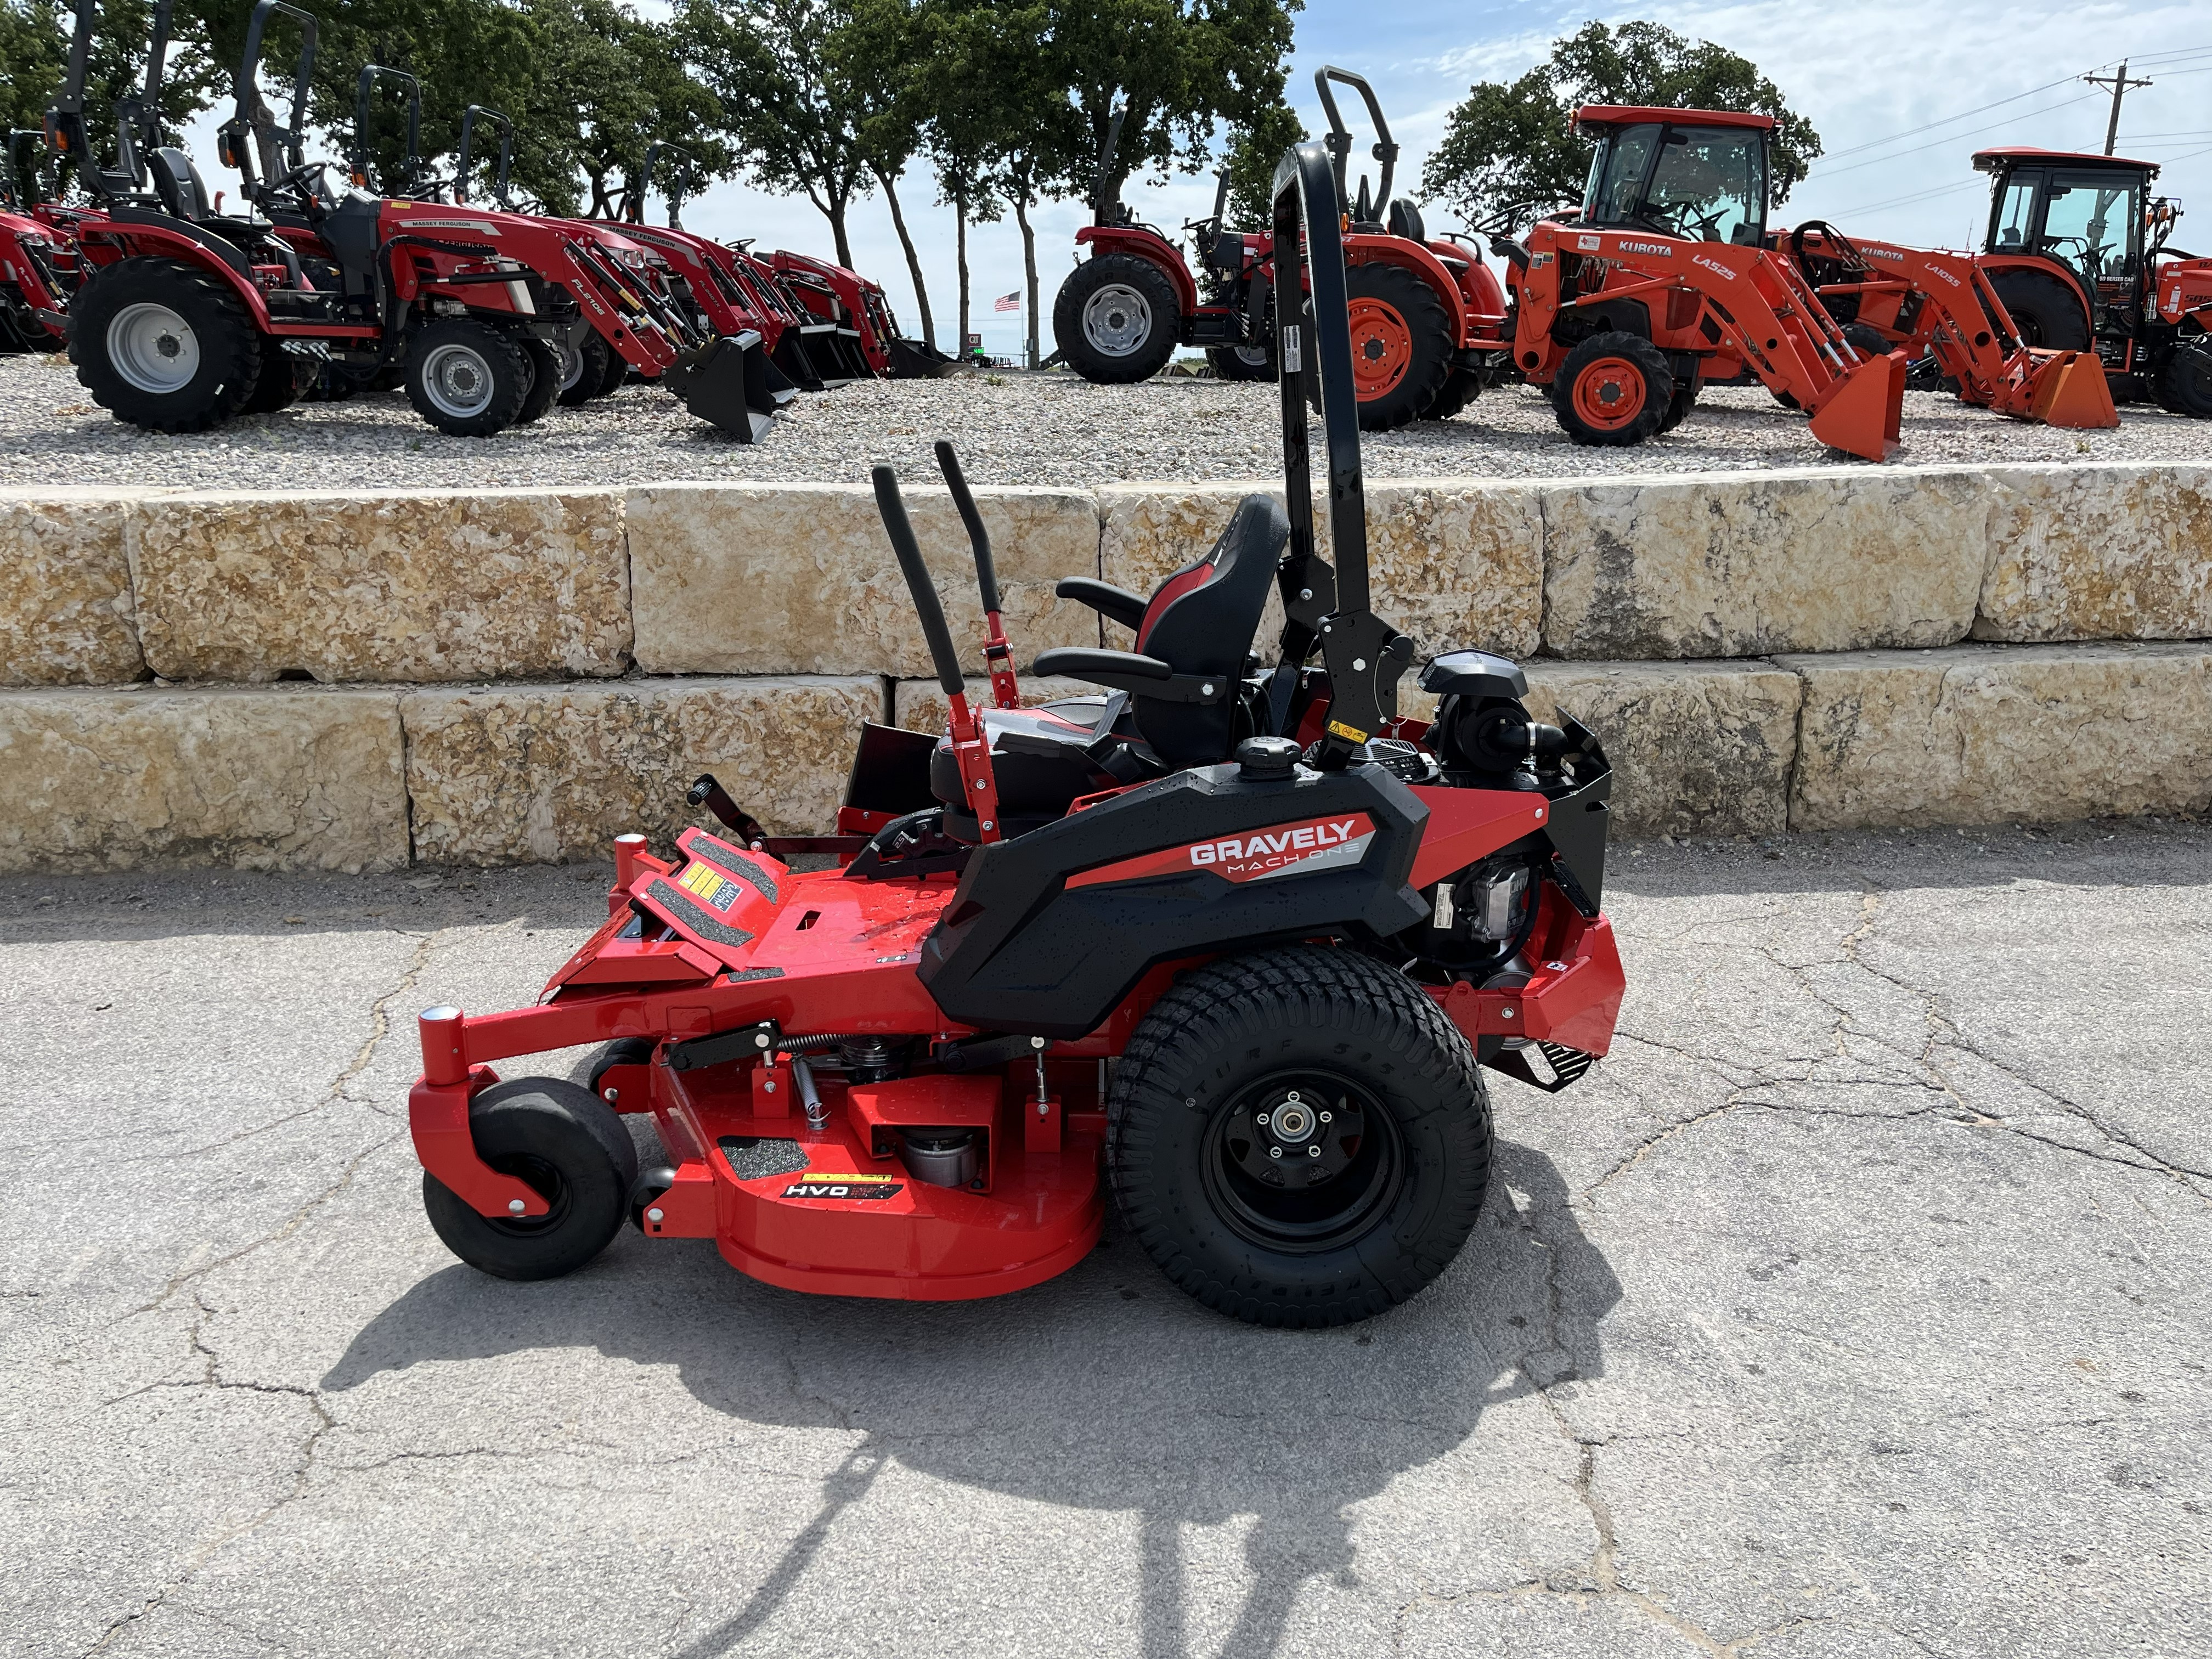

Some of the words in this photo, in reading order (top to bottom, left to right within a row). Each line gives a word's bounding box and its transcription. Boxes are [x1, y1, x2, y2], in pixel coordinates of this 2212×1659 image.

[609, 227, 637, 236] MASSEY
[639, 233, 675, 247] FERGUSON
[1619, 241, 1672, 258] KUBOTA
[1861, 246, 1904, 262] KUBOTA
[1692, 254, 1737, 281] LA525
[1924, 262, 1961, 287] LA1055
[571, 279, 605, 315] FL2106
[969, 335, 980, 344] QT
[1190, 819, 1356, 866] GRAVELY
[1227, 854, 1300, 874] MACH
[1308, 842, 1360, 860] ONE
[1510, 876, 1529, 894] OHV
[1194, 1039, 1293, 1094] TURF
[1333, 1042, 1396, 1075] 505
[786, 1185, 849, 1196] HVO
